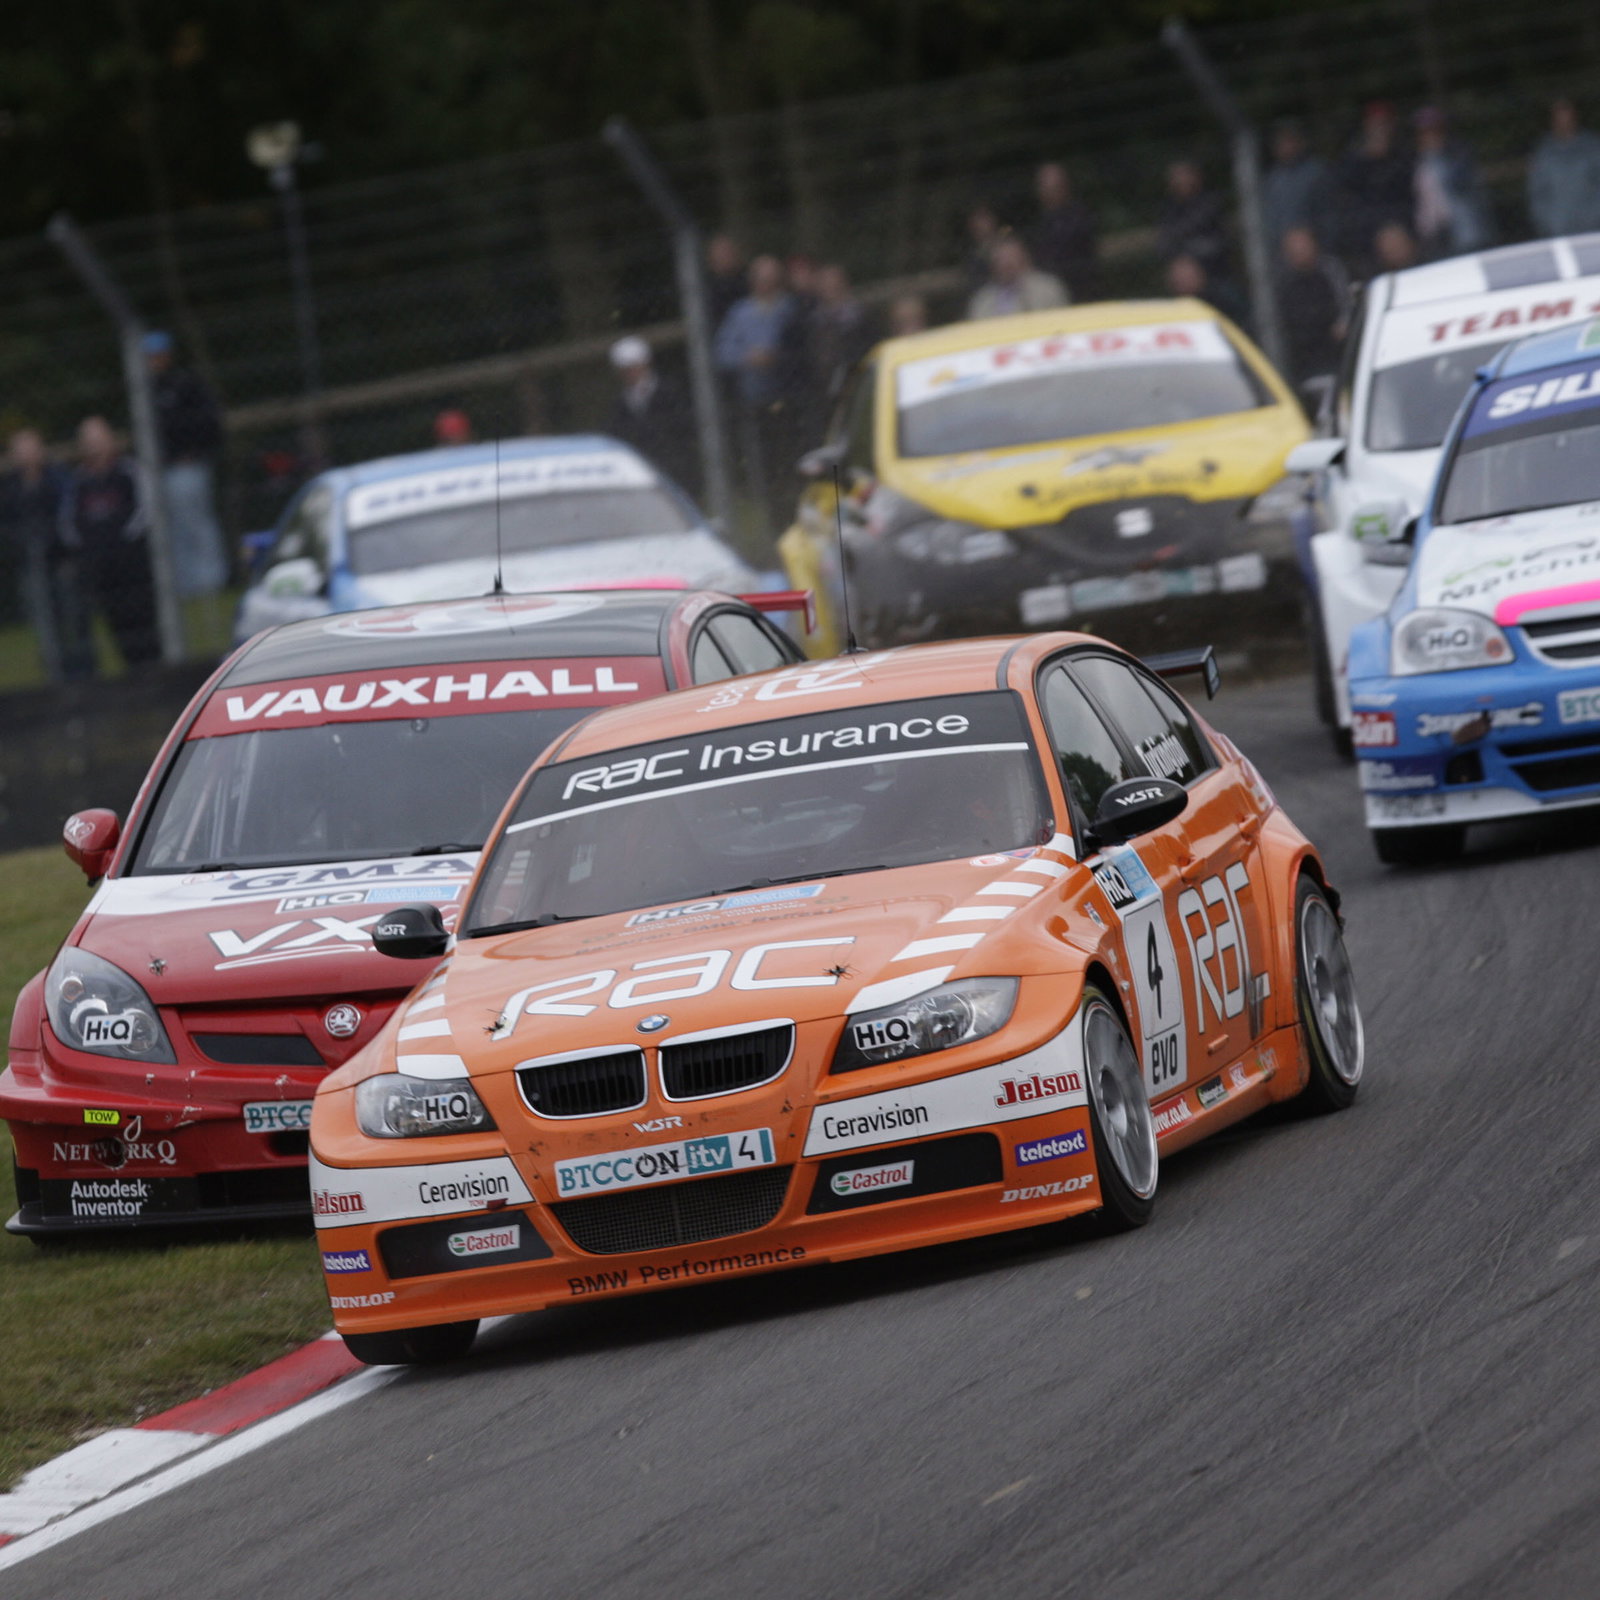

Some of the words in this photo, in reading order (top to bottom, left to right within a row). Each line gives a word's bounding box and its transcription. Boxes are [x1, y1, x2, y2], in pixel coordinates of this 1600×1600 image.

[1428, 296, 1578, 342] TEAM
[1429, 629, 1469, 649] HiQ
[226, 667, 638, 722] VAUXHALL
[699, 714, 971, 770] Insurance
[1115, 787, 1164, 807] WSR
[1095, 865, 1134, 904] HiQ
[284, 892, 365, 911] HiQ
[637, 900, 722, 924] HiQ
[1147, 920, 1164, 1020] 4
[85, 1018, 131, 1043] HiQ
[855, 1017, 910, 1048] HiQ
[1151, 1033, 1178, 1085] evo
[996, 1073, 1082, 1107] Jelson
[88, 1111, 114, 1121] TOW
[424, 1093, 470, 1122] HiQ
[823, 1103, 929, 1139] Ceravision
[632, 1116, 684, 1133] WSR
[157, 1140, 177, 1164] Q
[688, 1143, 727, 1169] itv
[738, 1136, 756, 1161] 4
[1018, 1132, 1086, 1163] teletext
[71, 1179, 148, 1198] Autodesk
[419, 1172, 509, 1204] Ceravision
[851, 1165, 909, 1190] Castrol
[1000, 1174, 1094, 1203] DUNLOP
[72, 1199, 143, 1215] Inventor
[466, 1229, 515, 1252] Castrol
[567, 1269, 628, 1296] BMW
[638, 1245, 807, 1284] Performance
[330, 1291, 395, 1309] DUNLOP
